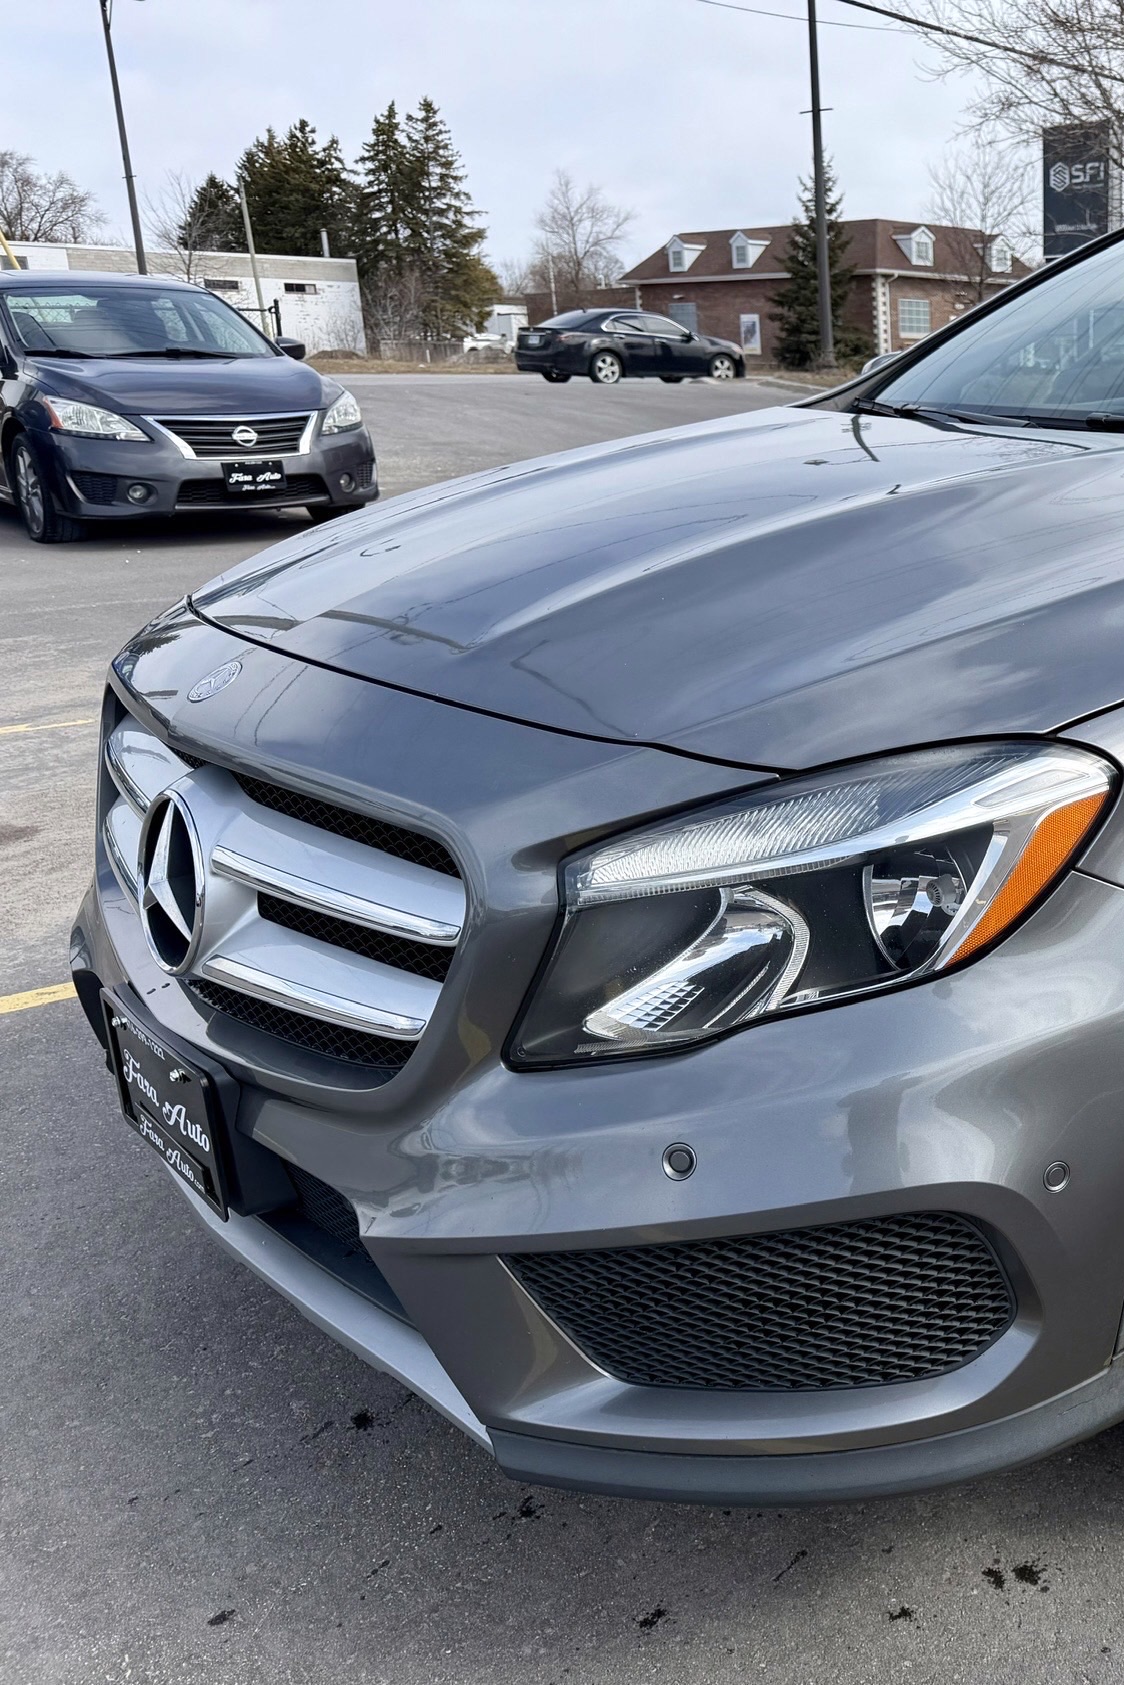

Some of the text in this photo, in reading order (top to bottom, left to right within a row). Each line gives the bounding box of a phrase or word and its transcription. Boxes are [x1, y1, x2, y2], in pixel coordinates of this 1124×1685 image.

[1071, 162, 1105, 183] SFI
[256, 472, 281, 482] Auto
[123, 1049, 159, 1107] Fara
[162, 1102, 210, 1152] Auto
[140, 1114, 165, 1151] Fara
